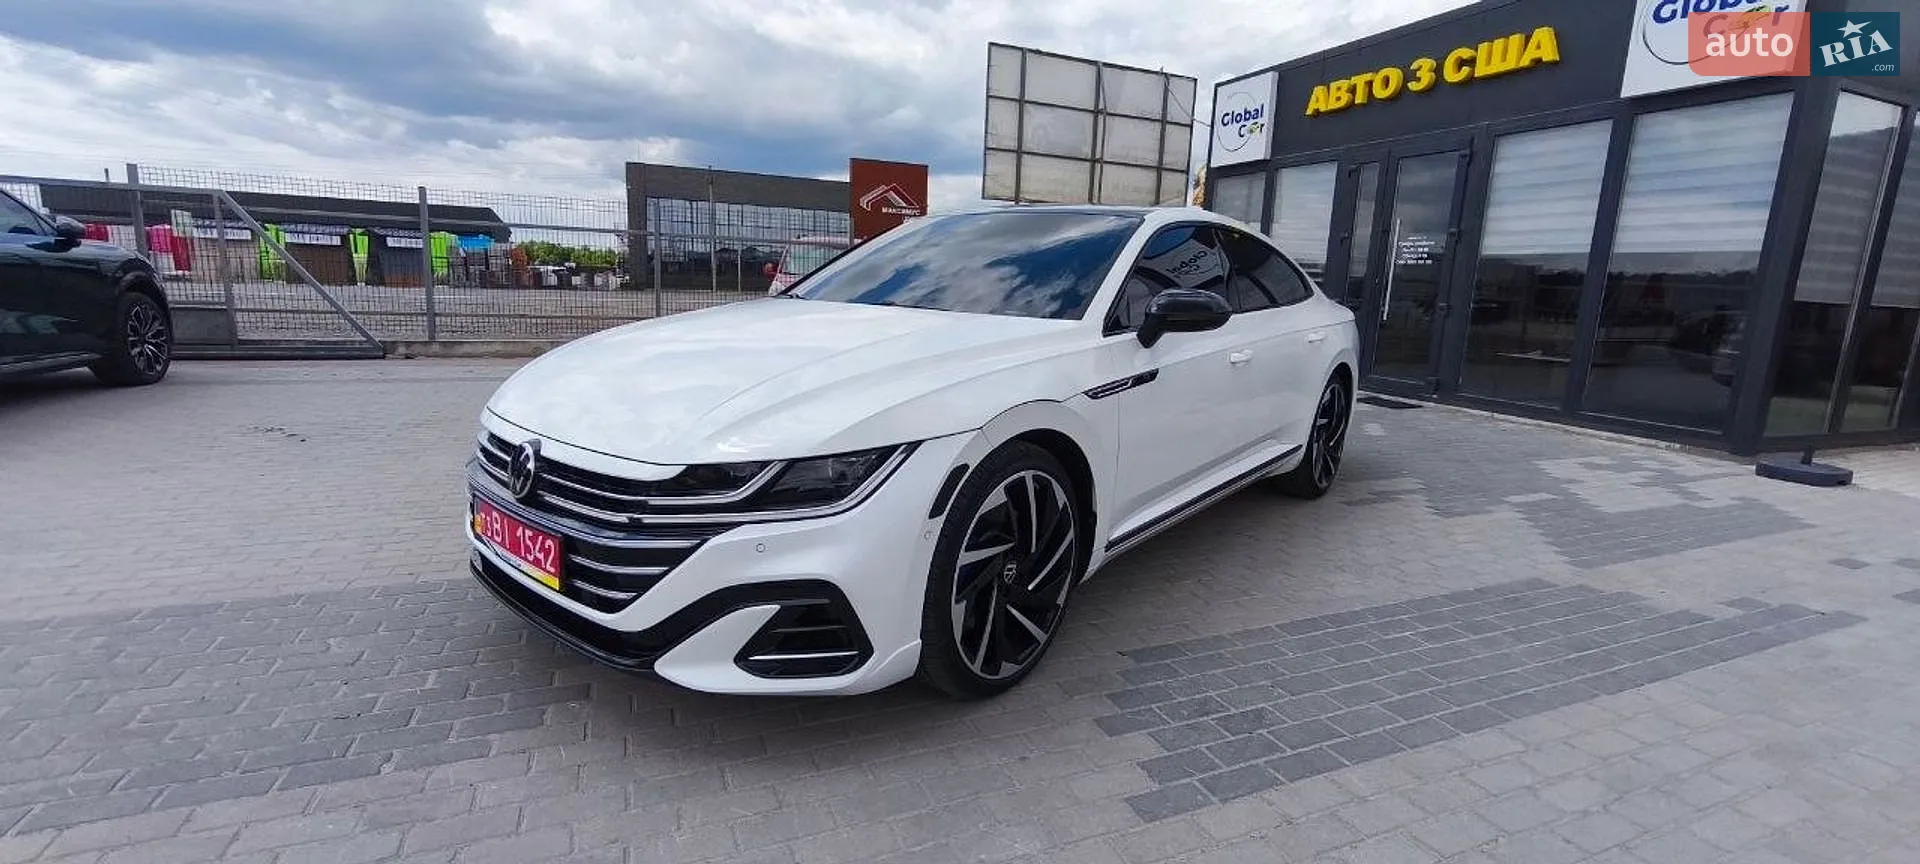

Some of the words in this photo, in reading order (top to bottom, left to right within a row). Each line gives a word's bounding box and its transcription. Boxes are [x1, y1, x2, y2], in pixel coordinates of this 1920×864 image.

[1305, 66, 1404, 116] АВТО
[1443, 26, 1560, 85] США
[1221, 103, 1264, 127] Global
[516, 526, 556, 573] 1542
